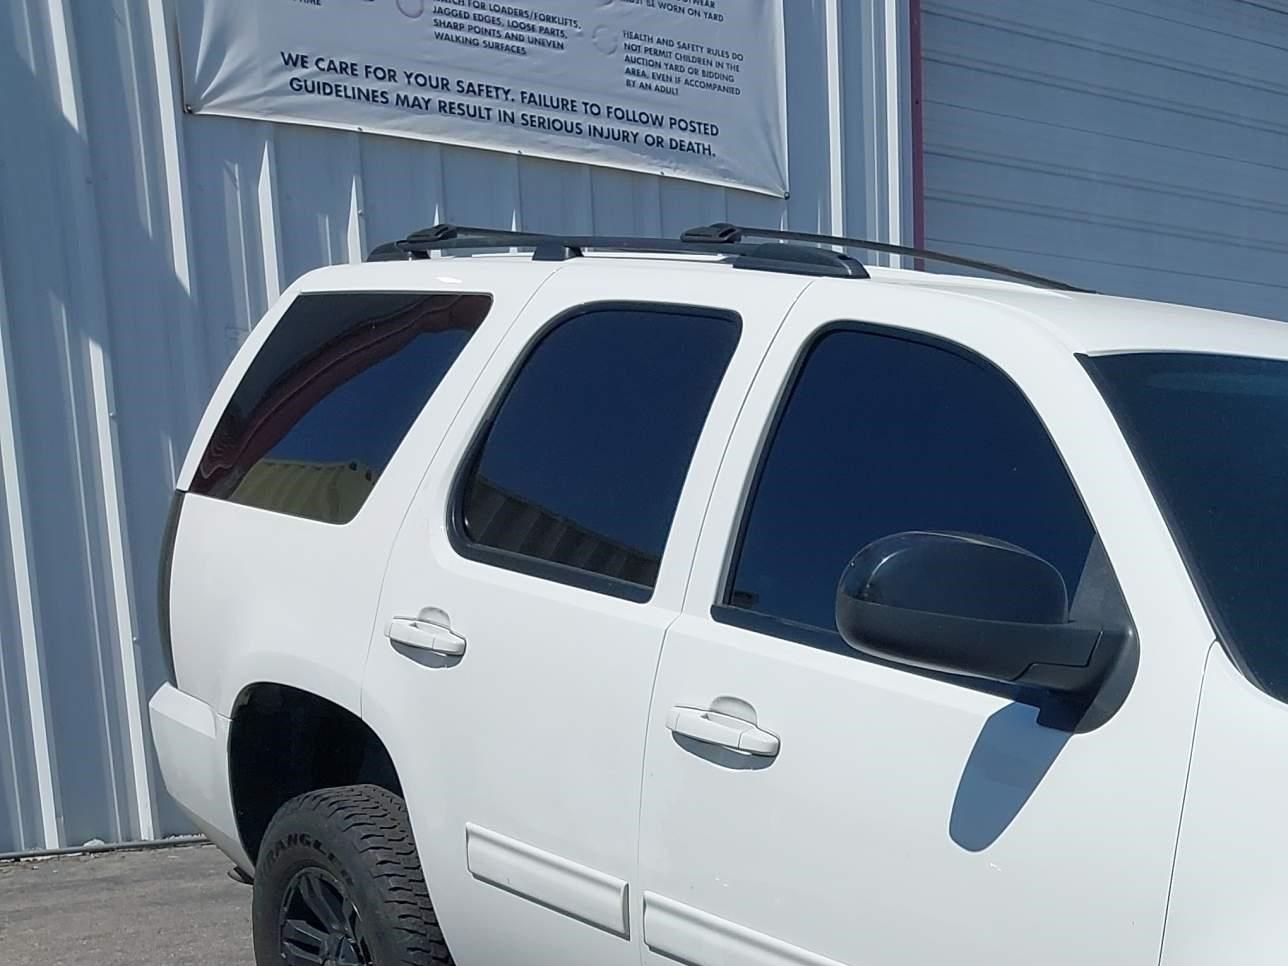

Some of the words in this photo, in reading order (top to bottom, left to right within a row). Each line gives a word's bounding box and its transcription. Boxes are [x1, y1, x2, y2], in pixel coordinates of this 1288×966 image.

[432, 5, 470, 20] JAGGED
[507, 20, 536, 33] LOOSE
[539, 26, 568, 39] PARTS,
[658, 2, 685, 14] WORN
[687, 8, 701, 17] ON
[703, 12, 724, 22] YARD
[433, 18, 465, 32] SHARP
[467, 24, 501, 38] POINTS
[504, 31, 525, 42] AND
[527, 36, 564, 50] UNEVEN
[434, 31, 479, 47] WALKING
[482, 40, 527, 56] SURFACES
[623, 30, 653, 44] HEALTH
[656, 37, 675, 48] AND
[677, 41, 704, 54] SAFETY
[706, 48, 730, 59] RULES
[732, 52, 744, 62] DO
[624, 42, 641, 53] NOT
[644, 47, 672, 59] PERMIT
[674, 52, 713, 67] CHILDREN
[715, 61, 724, 70] IN
[726, 64, 740, 73] THE
[624, 55, 662, 69] AUCTION
[663, 62, 685, 73] YARD
[687, 66, 699, 76] OR
[701, 69, 735, 83] BIDDING
[280, 51, 309, 69] WE
[314, 57, 358, 77] CARE
[364, 65, 398, 83] FOR
[404, 71, 450, 91] YOUR
[456, 79, 515, 102] SAFETY.
[520, 90, 578, 113] FAILURE
[582, 101, 601, 116] TO
[606, 105, 664, 128] FOLLOW
[669, 117, 719, 137] POSTED
[626, 79, 636, 88] BY
[638, 81, 652, 91] AN
[651, 71, 673, 83] EVEN
[674, 77, 681, 85] IF
[684, 78, 741, 96] ACCOMPANIED
[289, 77, 389, 105] GUIDELINES
[395, 93, 432, 111] MAY
[438, 99, 492, 121] RESULT
[498, 109, 515, 124] IN
[520, 112, 583, 135] SERIOUS
[588, 125, 640, 144] INJURY
[644, 134, 664, 149] OR
[669, 139, 716, 157] DEATH.
